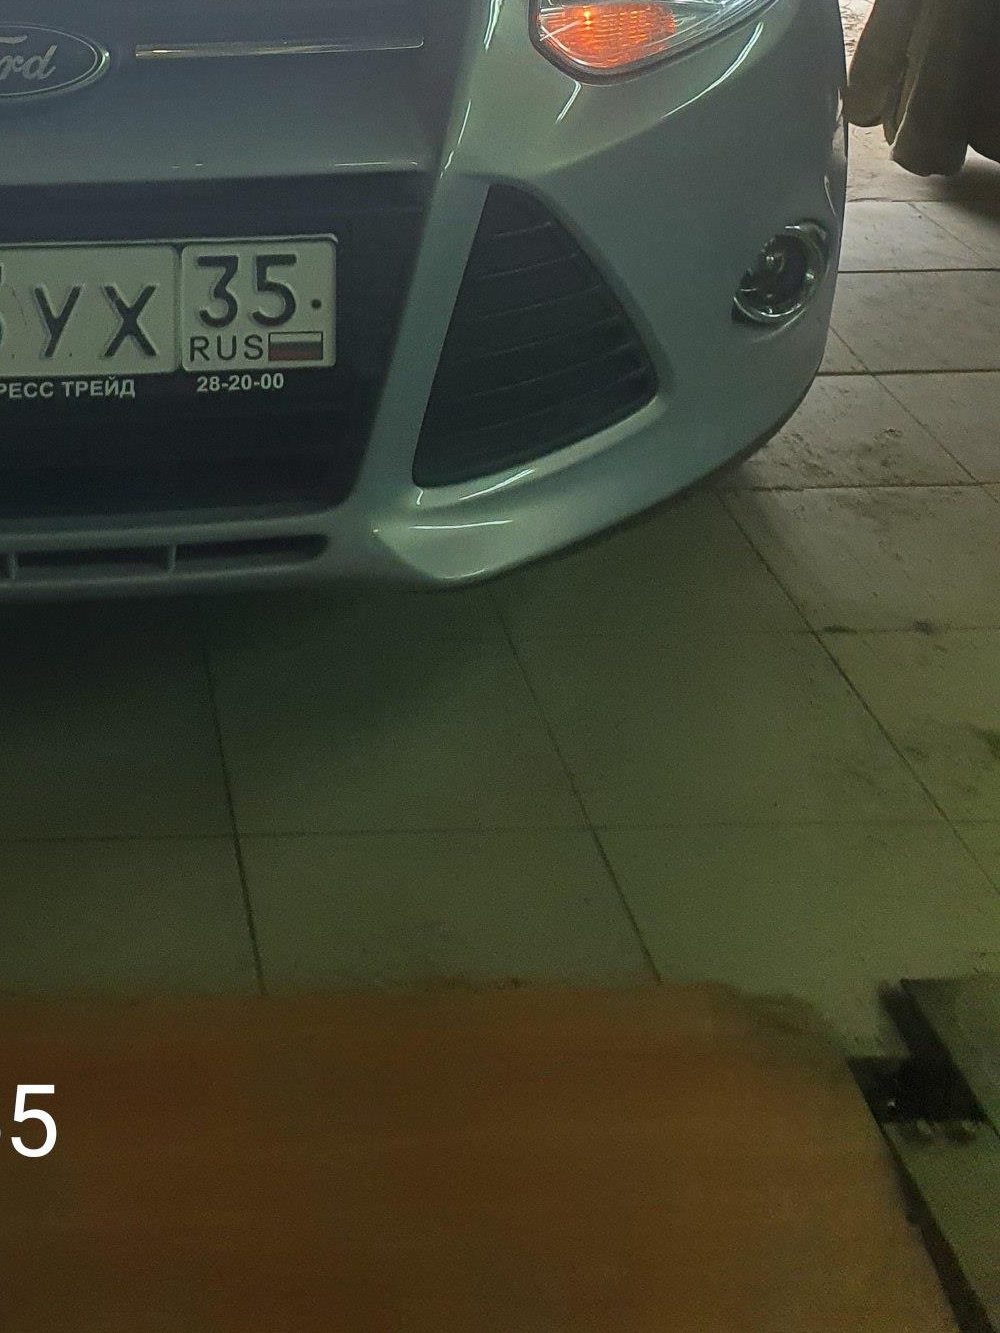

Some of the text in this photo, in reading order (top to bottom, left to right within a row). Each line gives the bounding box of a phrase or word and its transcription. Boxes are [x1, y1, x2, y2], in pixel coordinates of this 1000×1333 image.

[195, 253, 300, 328] 35
[188, 333, 265, 363] RUS
[60, 377, 137, 399] ТРЕЙД
[196, 372, 285, 393] 28-20-00
